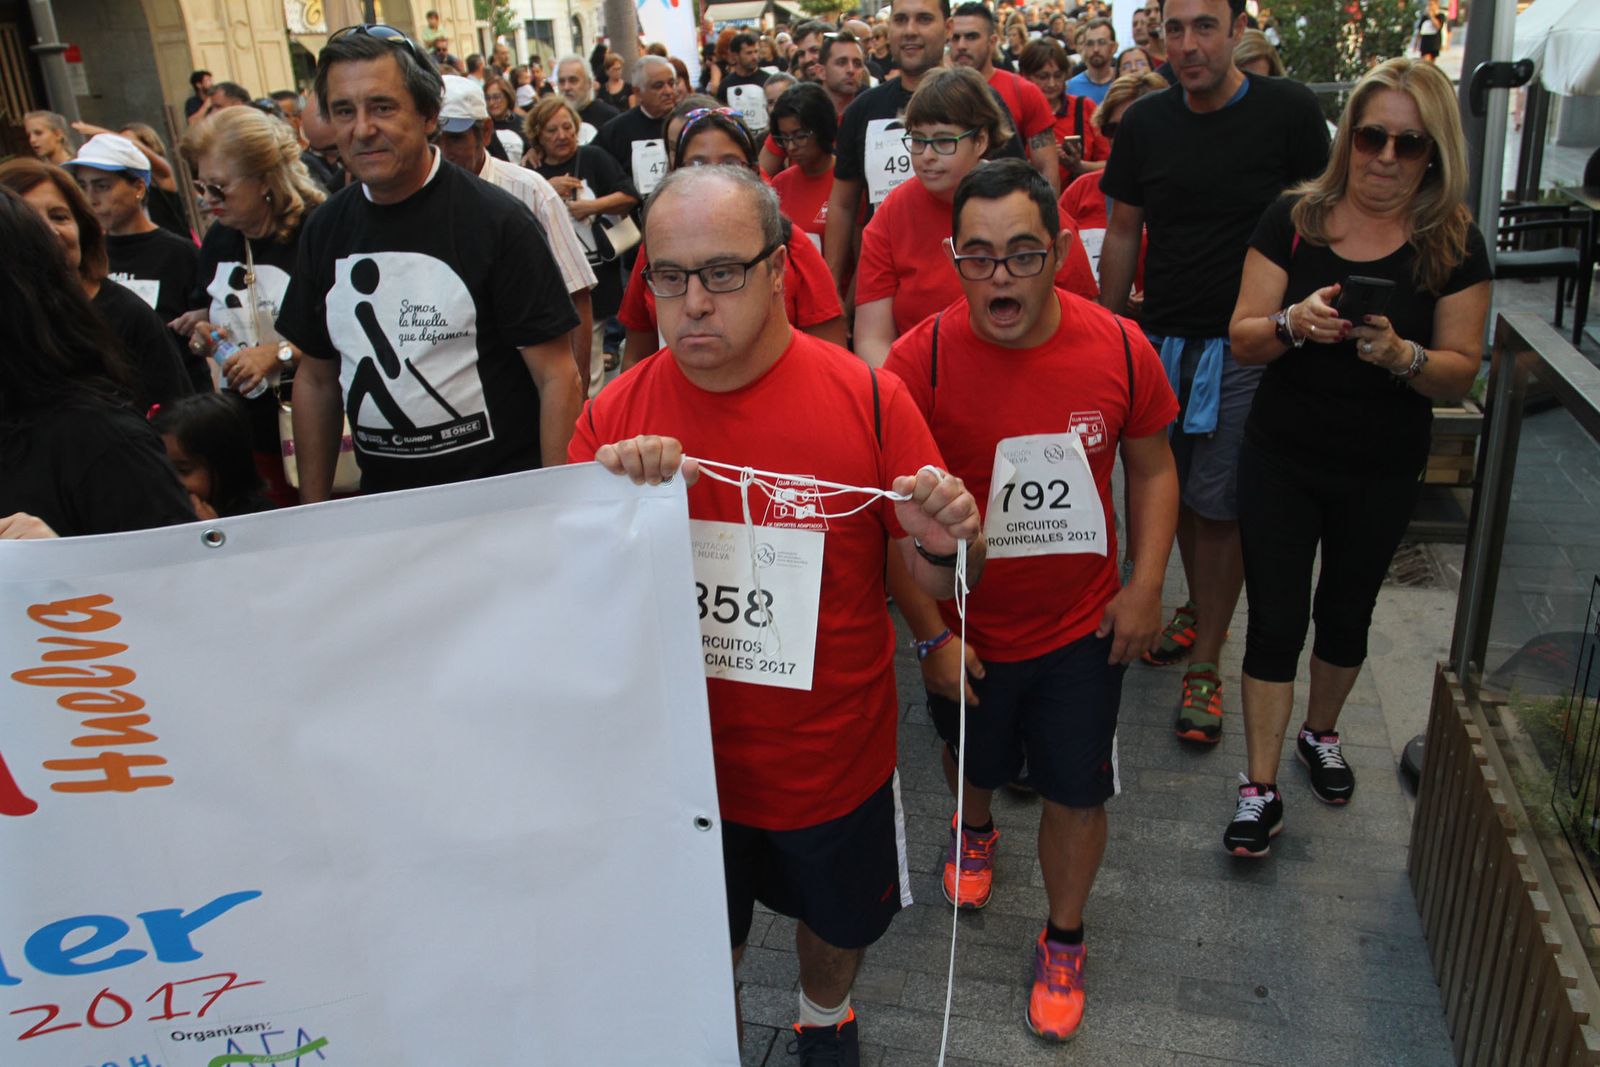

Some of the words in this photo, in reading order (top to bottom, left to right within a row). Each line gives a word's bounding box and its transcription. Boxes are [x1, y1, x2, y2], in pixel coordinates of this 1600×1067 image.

[400, 299, 437, 314] Somos
[399, 312, 409, 327] la
[412, 312, 448, 327] huella
[399, 333, 416, 347] que
[419, 327, 470, 346] dejamos
[452, 421, 478, 436] ONCE
[1003, 479, 1072, 513] 792
[1006, 519, 1068, 533] CIRCUITOS
[987, 531, 1064, 547] ROVINCIALES
[1067, 531, 1097, 542] 2017
[702, 634, 762, 654] RCUITOS
[705, 652, 754, 671] CIALES
[759, 659, 797, 675] 2017
[10, 593, 174, 793] Huelva
[0, 889, 263, 986] er
[9, 972, 266, 1041] 2017
[170, 1021, 272, 1043] Organizan:
